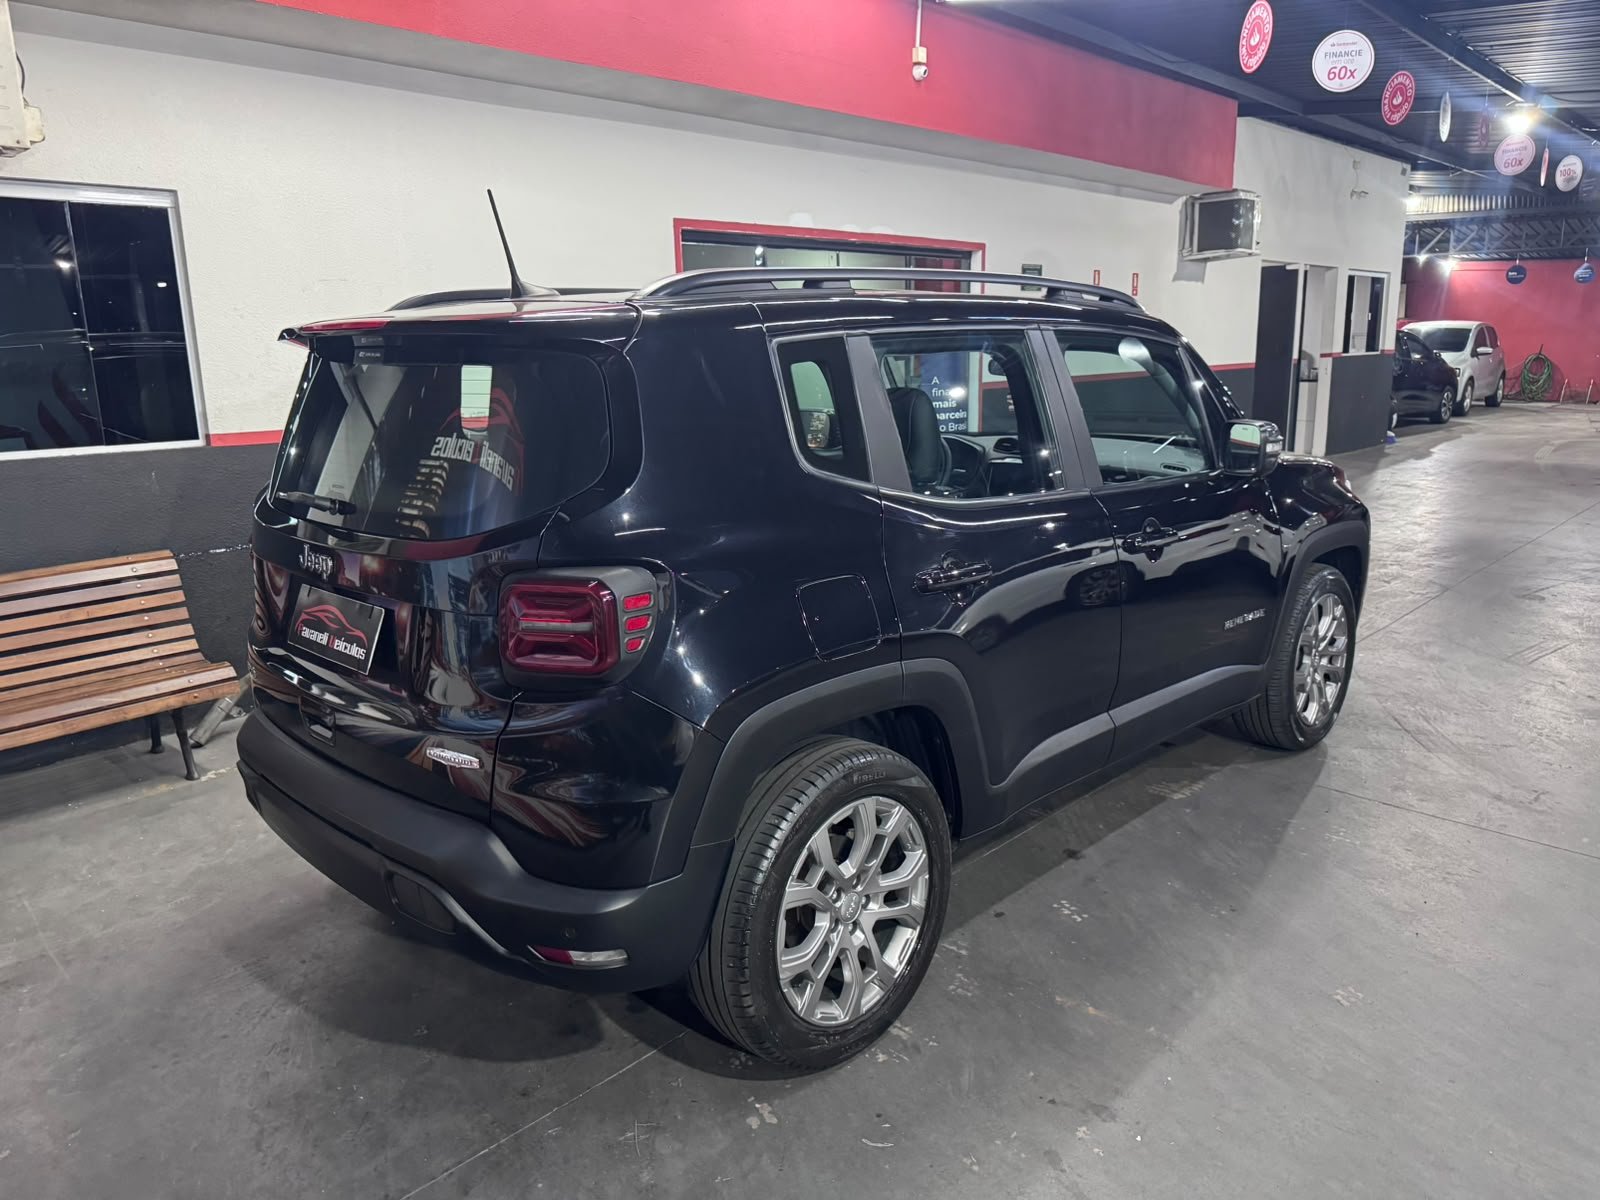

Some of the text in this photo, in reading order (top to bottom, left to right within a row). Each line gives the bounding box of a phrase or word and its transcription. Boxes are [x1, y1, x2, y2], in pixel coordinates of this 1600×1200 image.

[1240, 5, 1271, 65] FINANCIAMENTO
[1324, 49, 1363, 60] FINANCIE
[1327, 65, 1358, 81] 60x
[1384, 74, 1413, 119] FINANCIAMENTO
[1503, 157, 1524, 169] 60x
[931, 376, 940, 385] A
[932, 399, 957, 409] mais
[298, 544, 333, 581] Jeep
[297, 623, 367, 660] Pavaneli Veículos
